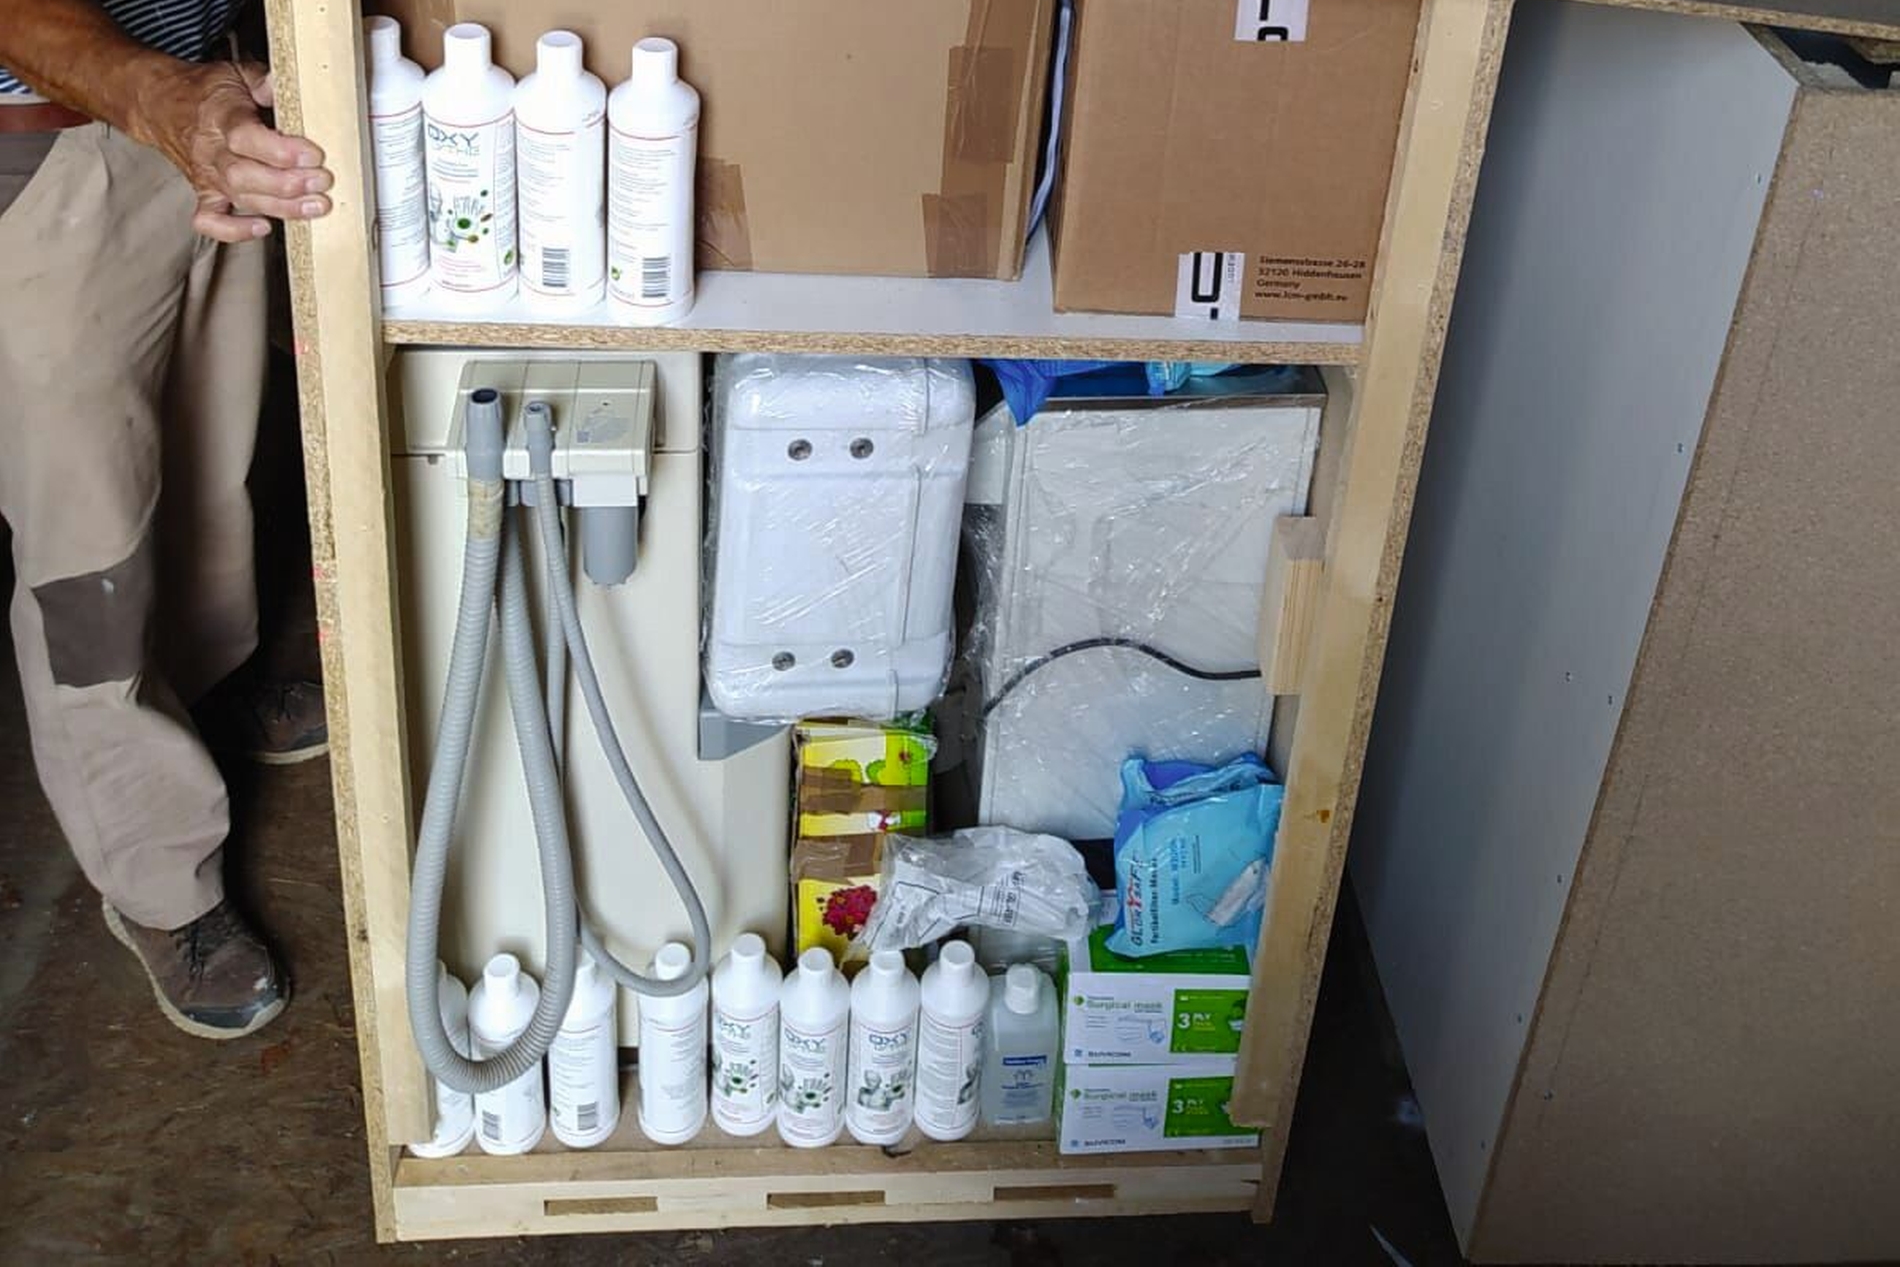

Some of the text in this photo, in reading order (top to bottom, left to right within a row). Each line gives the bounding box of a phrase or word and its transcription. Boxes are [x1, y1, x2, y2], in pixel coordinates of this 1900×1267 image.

[428, 123, 479, 147] OXY
[1256, 278, 1300, 290] Germany
[1177, 1012, 1191, 1029] 3
[1172, 1099, 1184, 1114] 3
